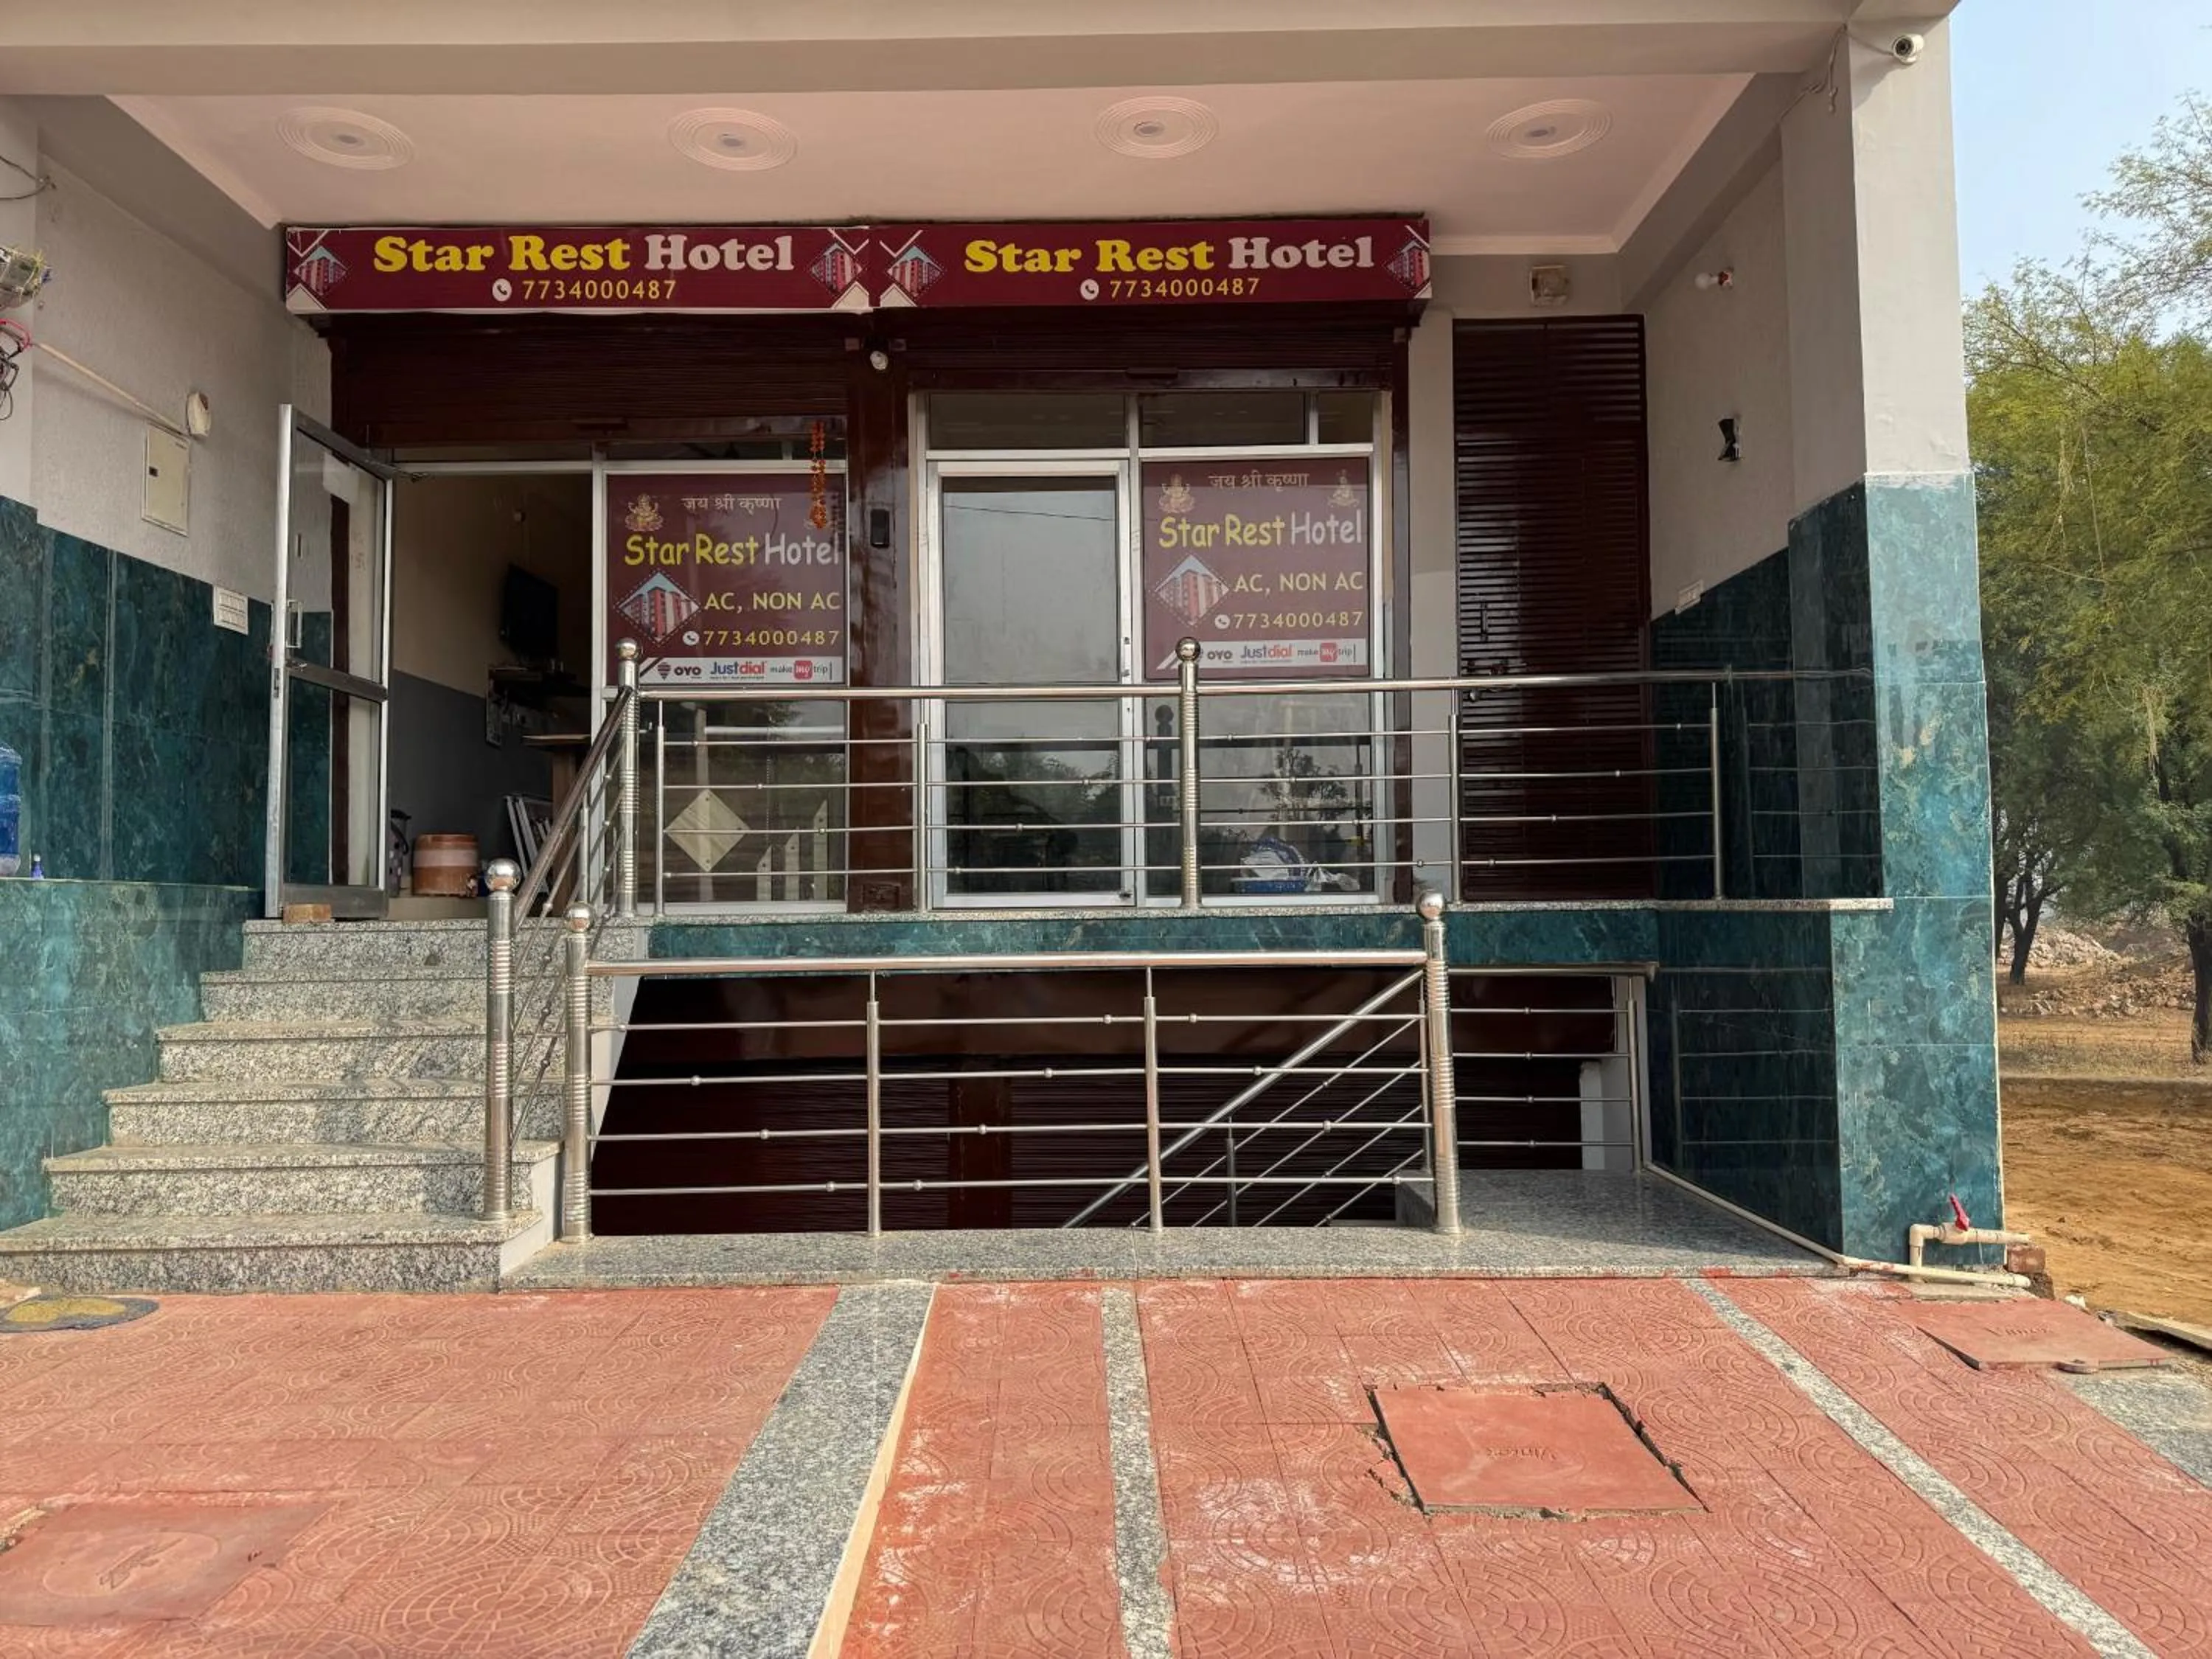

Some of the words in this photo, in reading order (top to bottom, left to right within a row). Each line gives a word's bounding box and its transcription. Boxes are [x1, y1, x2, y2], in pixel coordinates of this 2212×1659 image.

[373, 234, 494, 272] Star
[507, 234, 631, 271] Rest
[644, 234, 795, 271] Hotel
[964, 239, 1082, 274] Star
[1095, 237, 1216, 273] Rest
[1227, 235, 1375, 271] Hotel
[521, 278, 678, 301] 7734000487
[1109, 276, 1261, 299] 7734000487
[1208, 475, 1235, 489] जय
[1240, 469, 1262, 488] श्री
[681, 498, 708, 509] जय
[714, 493, 735, 509] श्री
[1158, 517, 1220, 548] Star
[1225, 513, 1285, 546] Rest
[1291, 509, 1362, 545] Hotel
[625, 534, 690, 566] Star
[695, 534, 758, 566] Rest
[765, 532, 840, 566] Hotel
[1234, 574, 1270, 595] AC,
[1279, 573, 1326, 591] NON
[1334, 571, 1363, 590] AC
[704, 593, 742, 613] AC,
[753, 593, 801, 611] NON
[811, 592, 841, 610] AC
[1234, 611, 1363, 628] 7734000487
[703, 630, 840, 646] 7734000487
